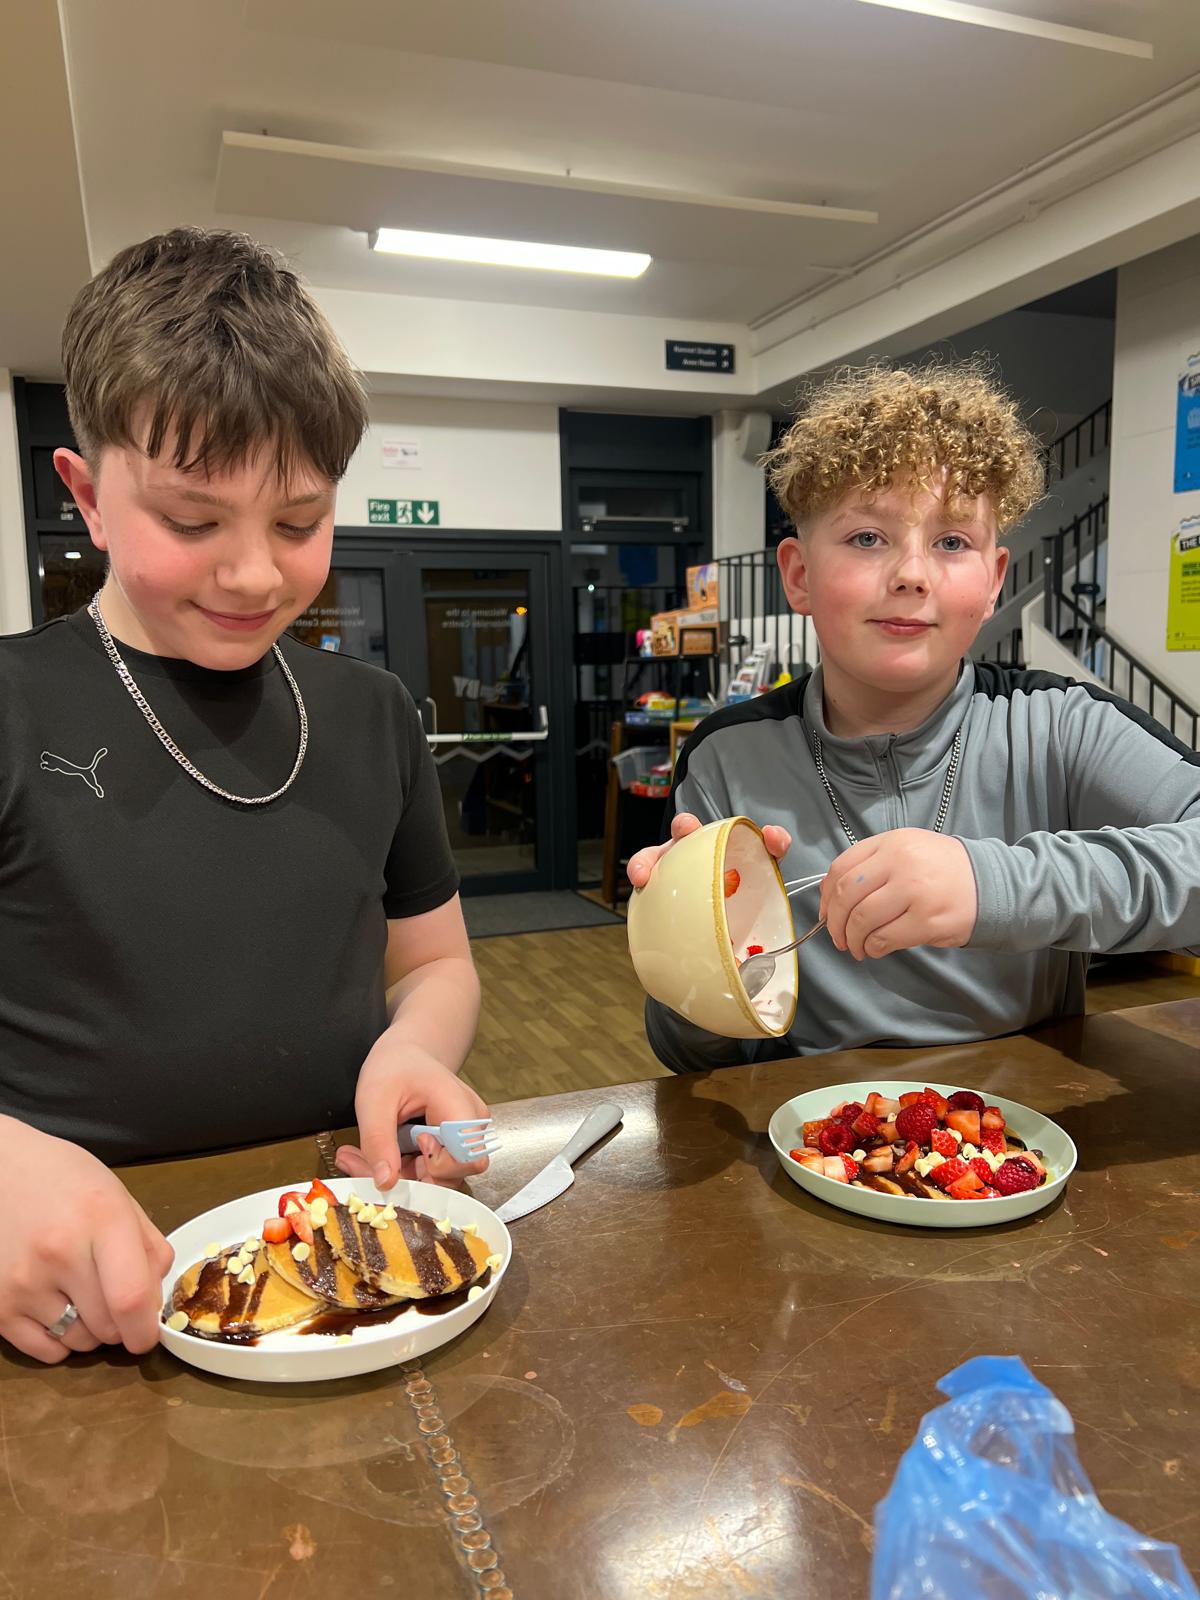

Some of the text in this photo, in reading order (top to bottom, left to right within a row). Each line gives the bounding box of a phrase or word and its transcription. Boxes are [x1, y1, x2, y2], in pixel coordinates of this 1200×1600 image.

[370, 501, 390, 511] Fire
[370, 512, 390, 522] exit
[1182, 537, 1197, 550] THE
